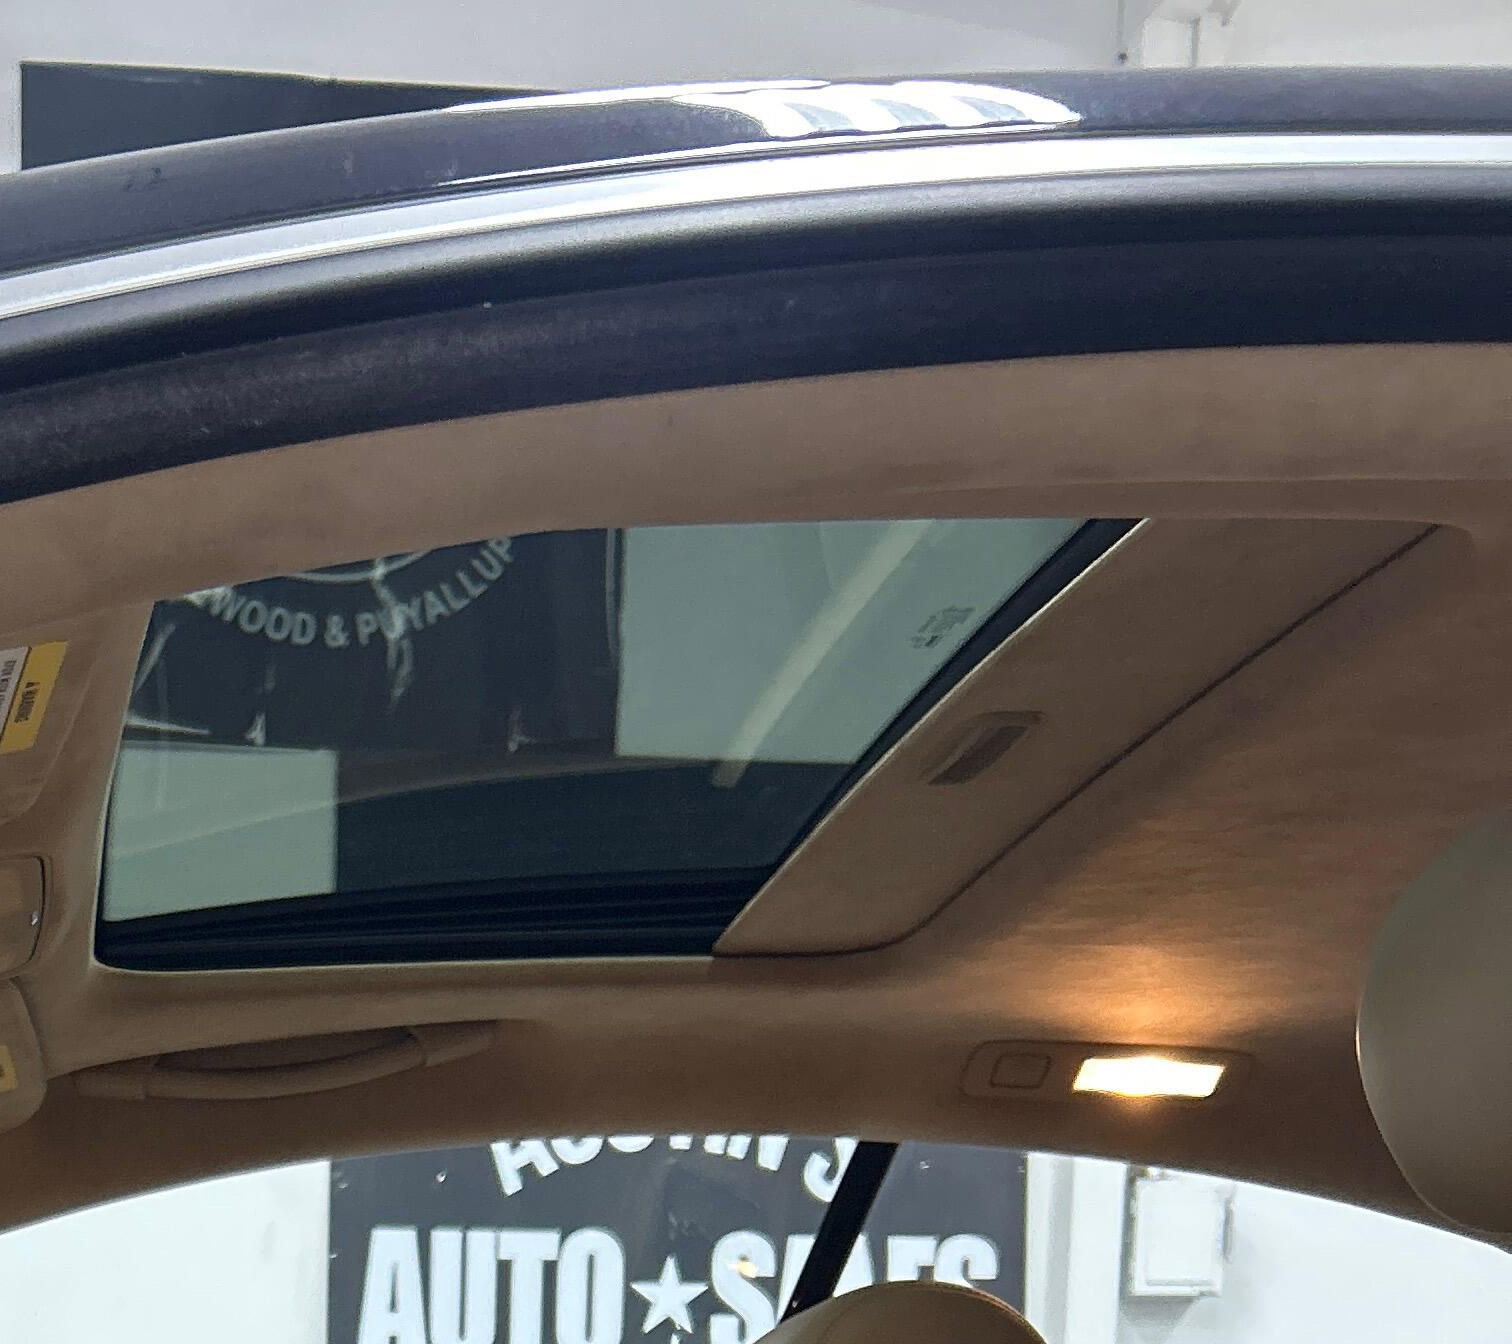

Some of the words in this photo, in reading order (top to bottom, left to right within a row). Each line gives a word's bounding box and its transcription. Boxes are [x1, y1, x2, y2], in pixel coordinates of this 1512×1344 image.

[186, 587, 317, 646] WOOD
[324, 615, 350, 648] &
[354, 536, 514, 647] PUYALLUP
